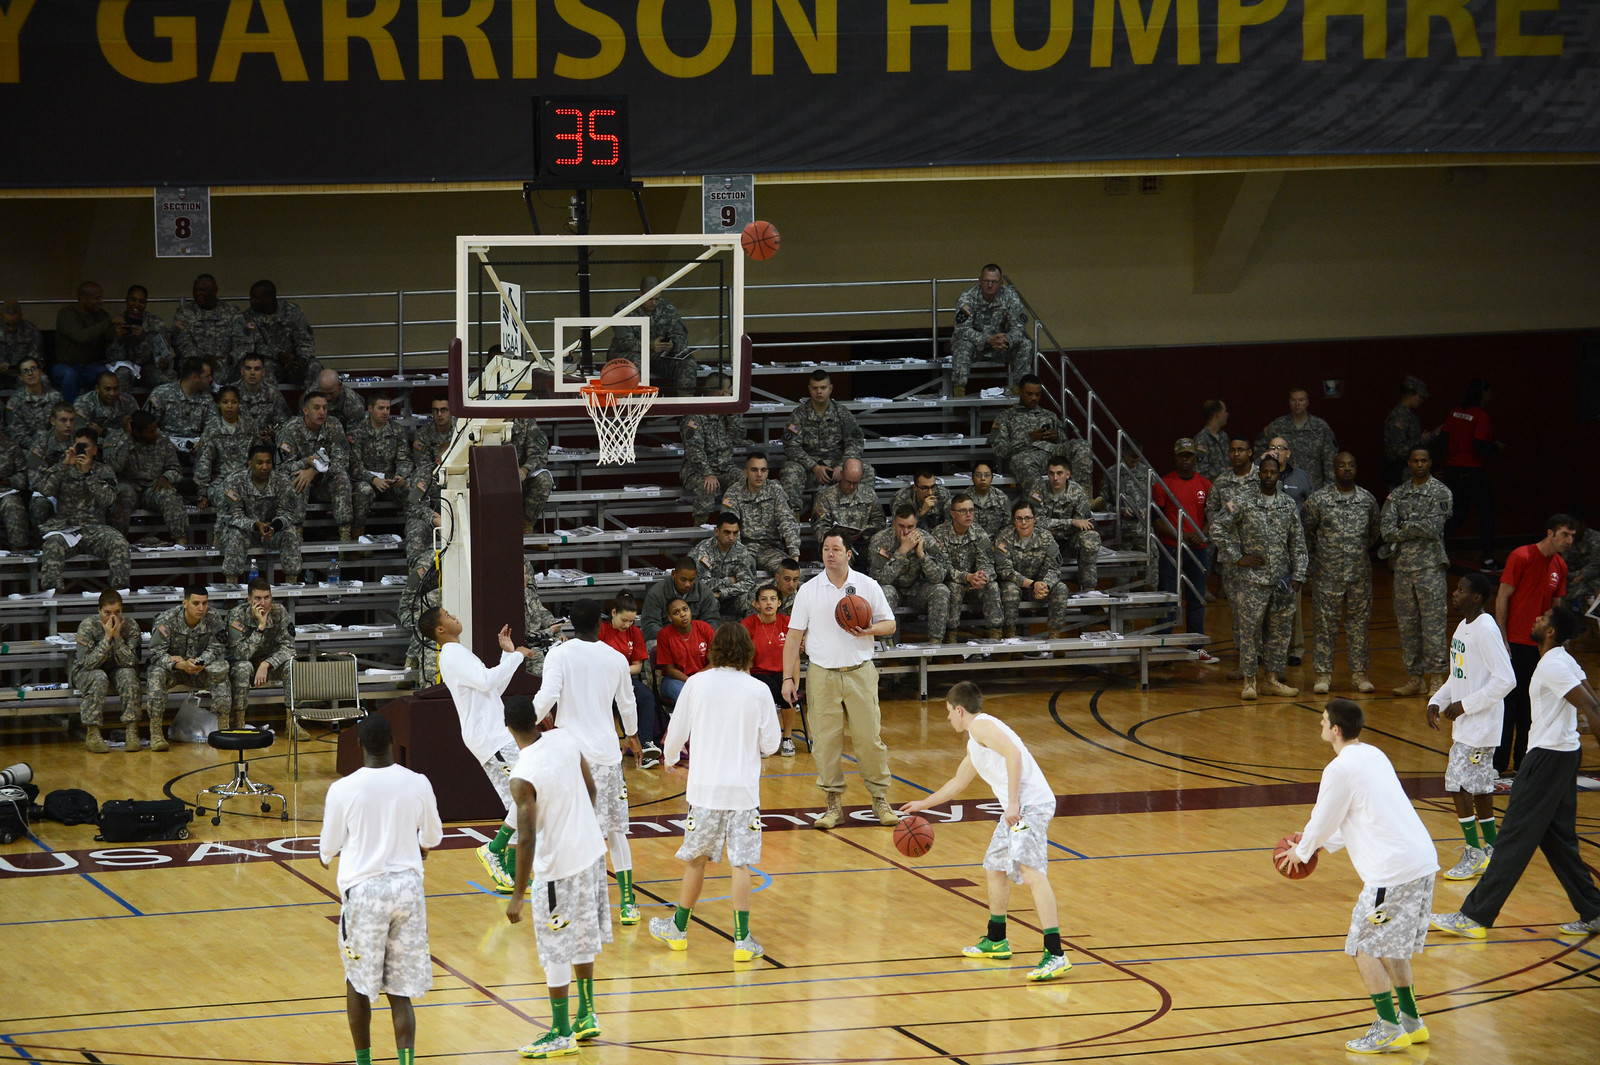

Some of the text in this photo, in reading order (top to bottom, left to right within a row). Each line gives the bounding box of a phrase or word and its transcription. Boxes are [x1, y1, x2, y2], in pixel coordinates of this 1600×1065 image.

[97, 0, 837, 83] GARRISON
[886, 0, 1564, 73] HUMPHRE
[555, 109, 619, 165] 35
[163, 202, 201, 211] SECTION
[710, 191, 746, 200] SECTION
[174, 216, 192, 239] 8
[720, 205, 736, 228] 9
[503, 332, 519, 353] USAA
